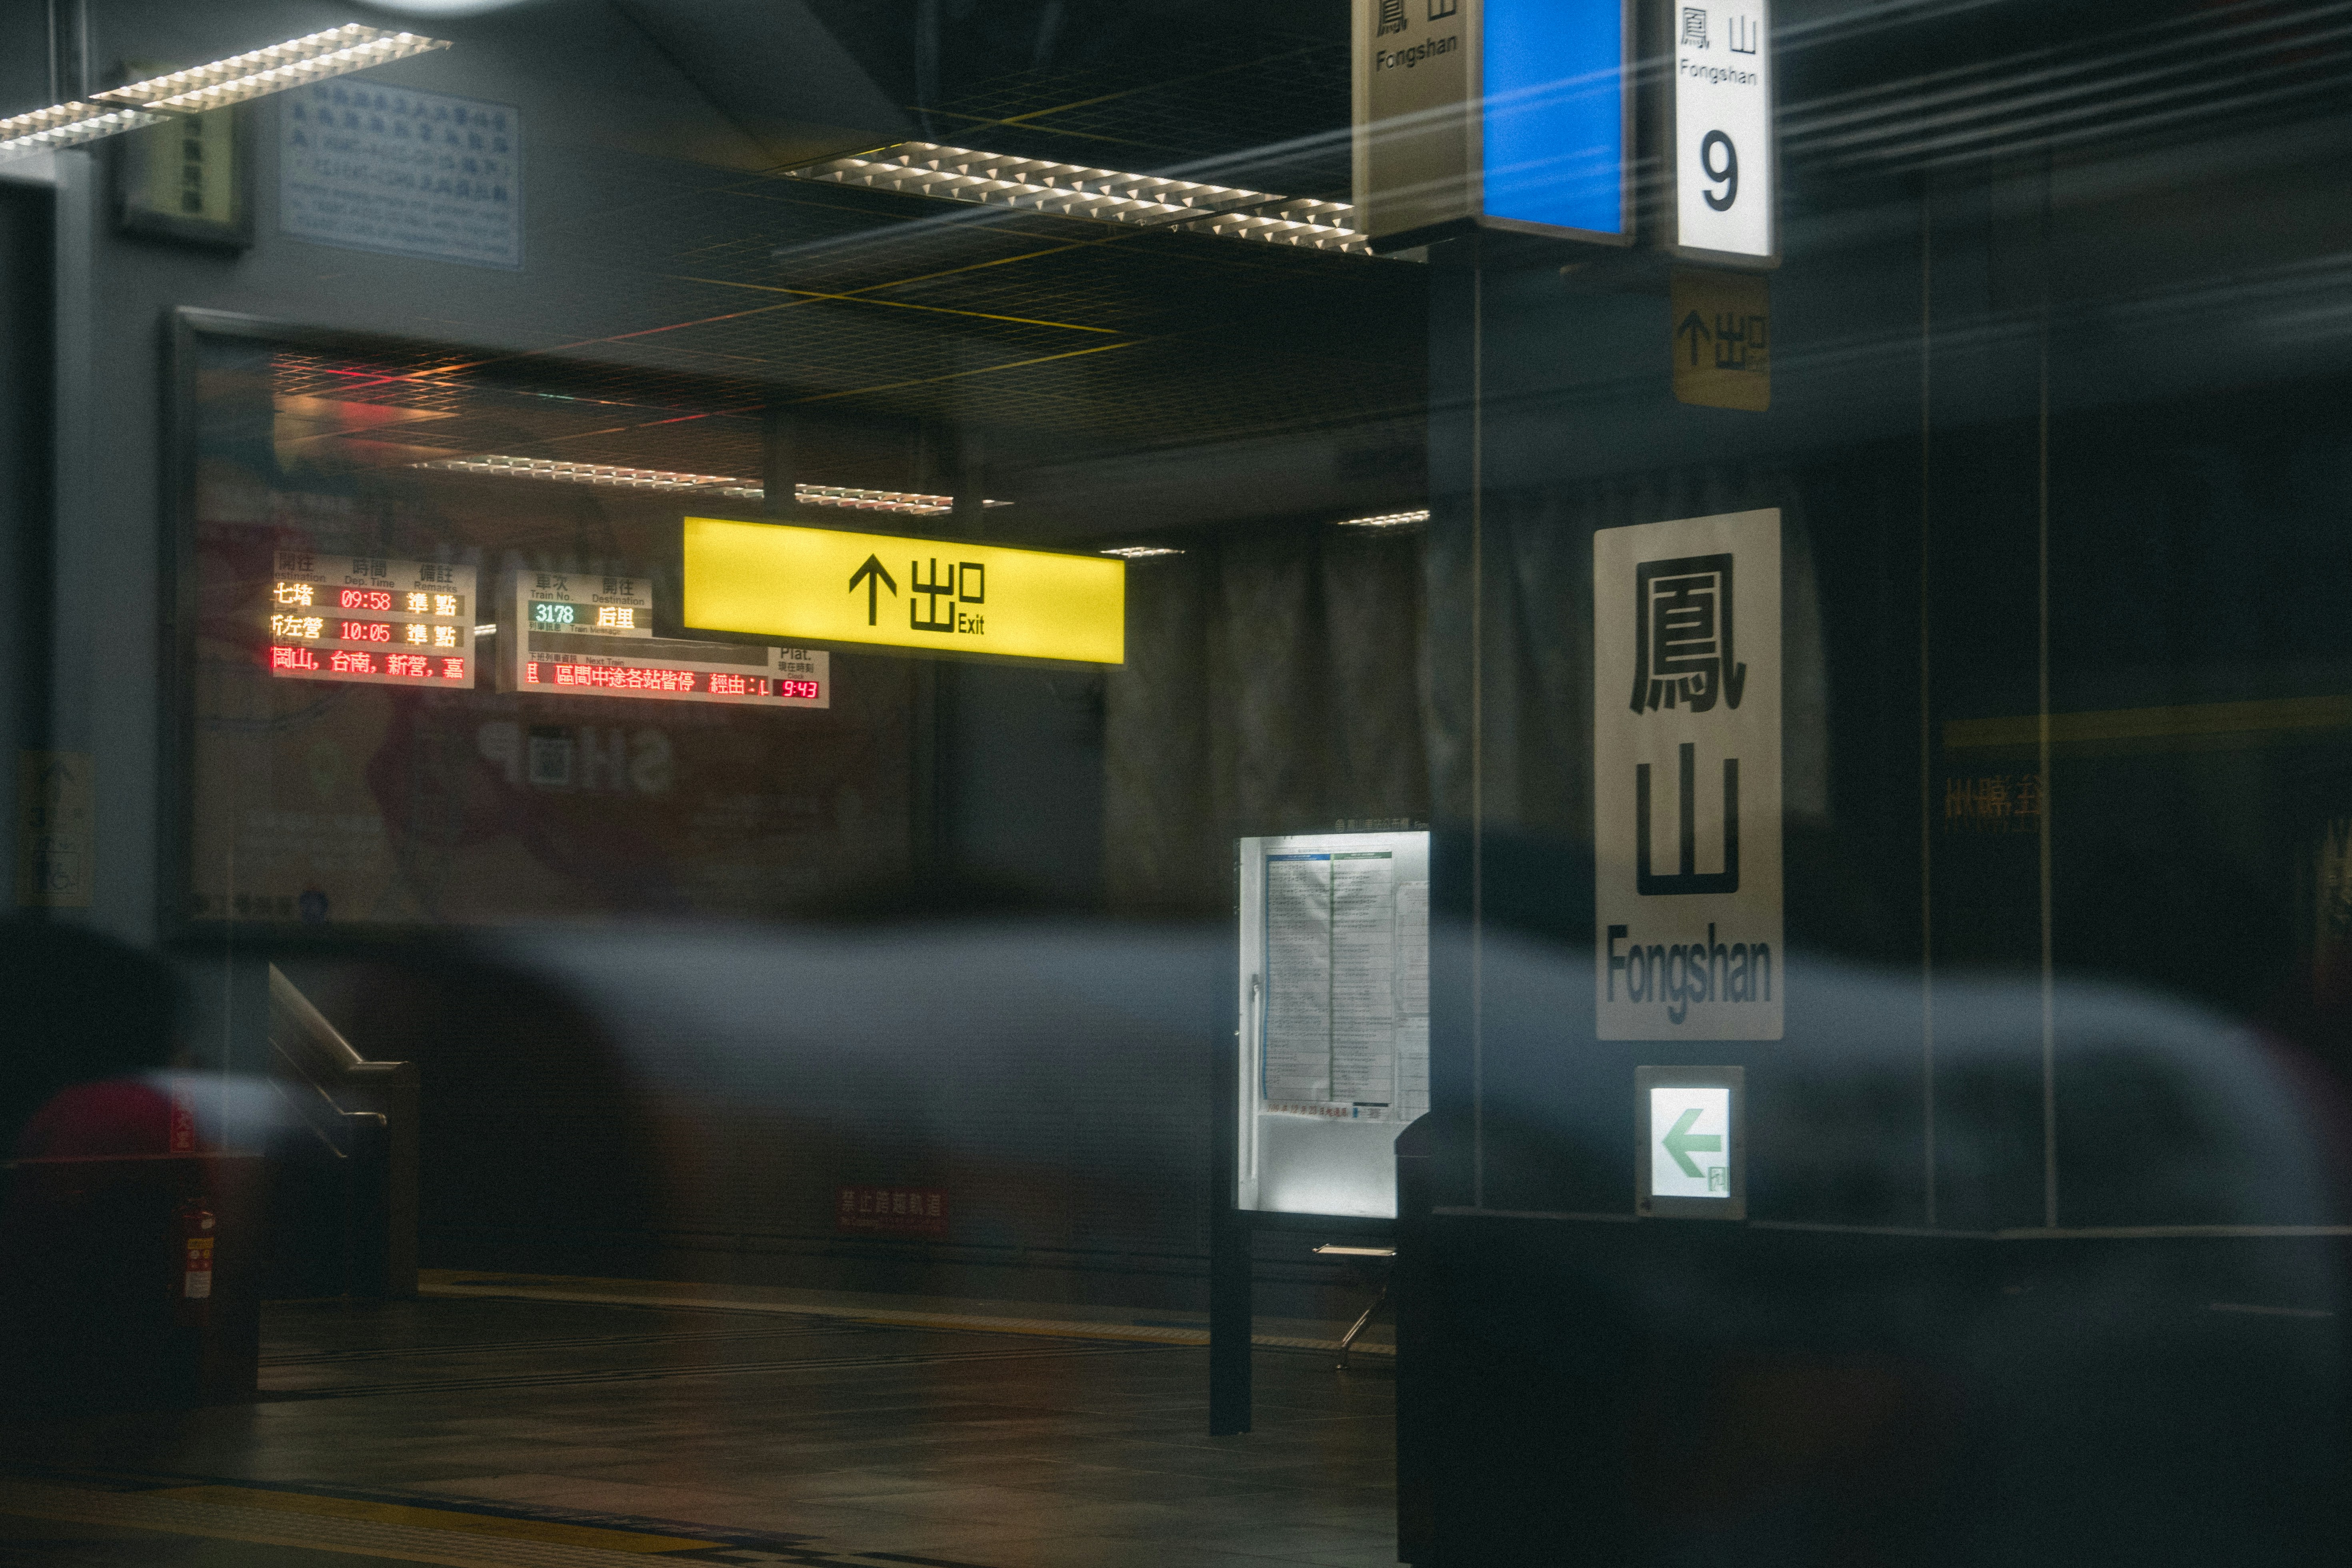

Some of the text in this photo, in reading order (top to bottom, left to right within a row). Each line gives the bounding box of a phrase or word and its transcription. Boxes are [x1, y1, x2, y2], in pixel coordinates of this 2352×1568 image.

[1681, 7, 1757, 55] 鳳山
[1376, 35, 1458, 72] Fongshan
[1680, 59, 1757, 85] Fongshan
[1701, 130, 1738, 212] 9
[1715, 312, 1766, 370] 出口
[353, 558, 387, 577] 時間
[420, 563, 453, 583] 備註
[344, 575, 395, 588] Dep. Time
[414, 581, 457, 593] Remarks
[536, 574, 568, 591] 車次
[602, 577, 634, 596] 開往
[341, 590, 391, 610] 09:58
[530, 590, 574, 601] Train No.
[592, 594, 645, 606] Destination
[910, 558, 985, 633] 出口
[536, 604, 574, 623] 3178
[597, 606, 634, 629] 后里
[341, 621, 391, 642] 10:05
[570, 625, 588, 633] Train
[958, 613, 985, 635] Exit
[586, 657, 624, 667] Next Train
[781, 647, 811, 661] Plat.
[778, 661, 814, 673] 現在時刻
[555, 664, 695, 692] 區間中途各站皆停
[783, 680, 818, 699] 9:43
[1630, 553, 1746, 896] 鳳山
[1607, 923, 1771, 1025] Fongshan
